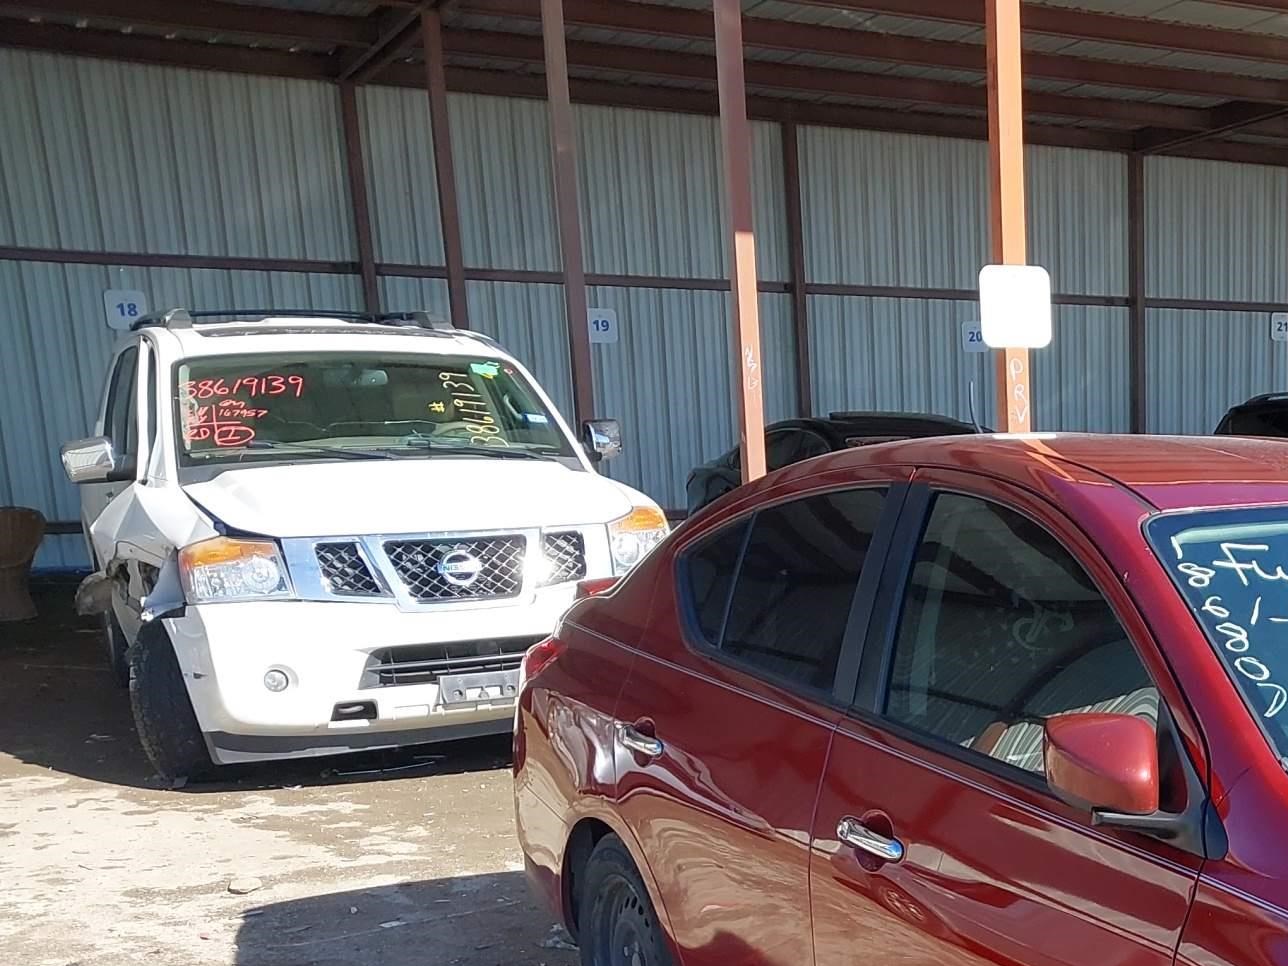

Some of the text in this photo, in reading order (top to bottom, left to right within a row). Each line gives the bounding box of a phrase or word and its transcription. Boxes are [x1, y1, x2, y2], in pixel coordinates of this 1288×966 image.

[115, 302, 139, 317] 18
[592, 319, 610, 332] 19
[1276, 321, 1288, 333] 21
[968, 331, 983, 342] 20
[178, 375, 304, 399] 38619139
